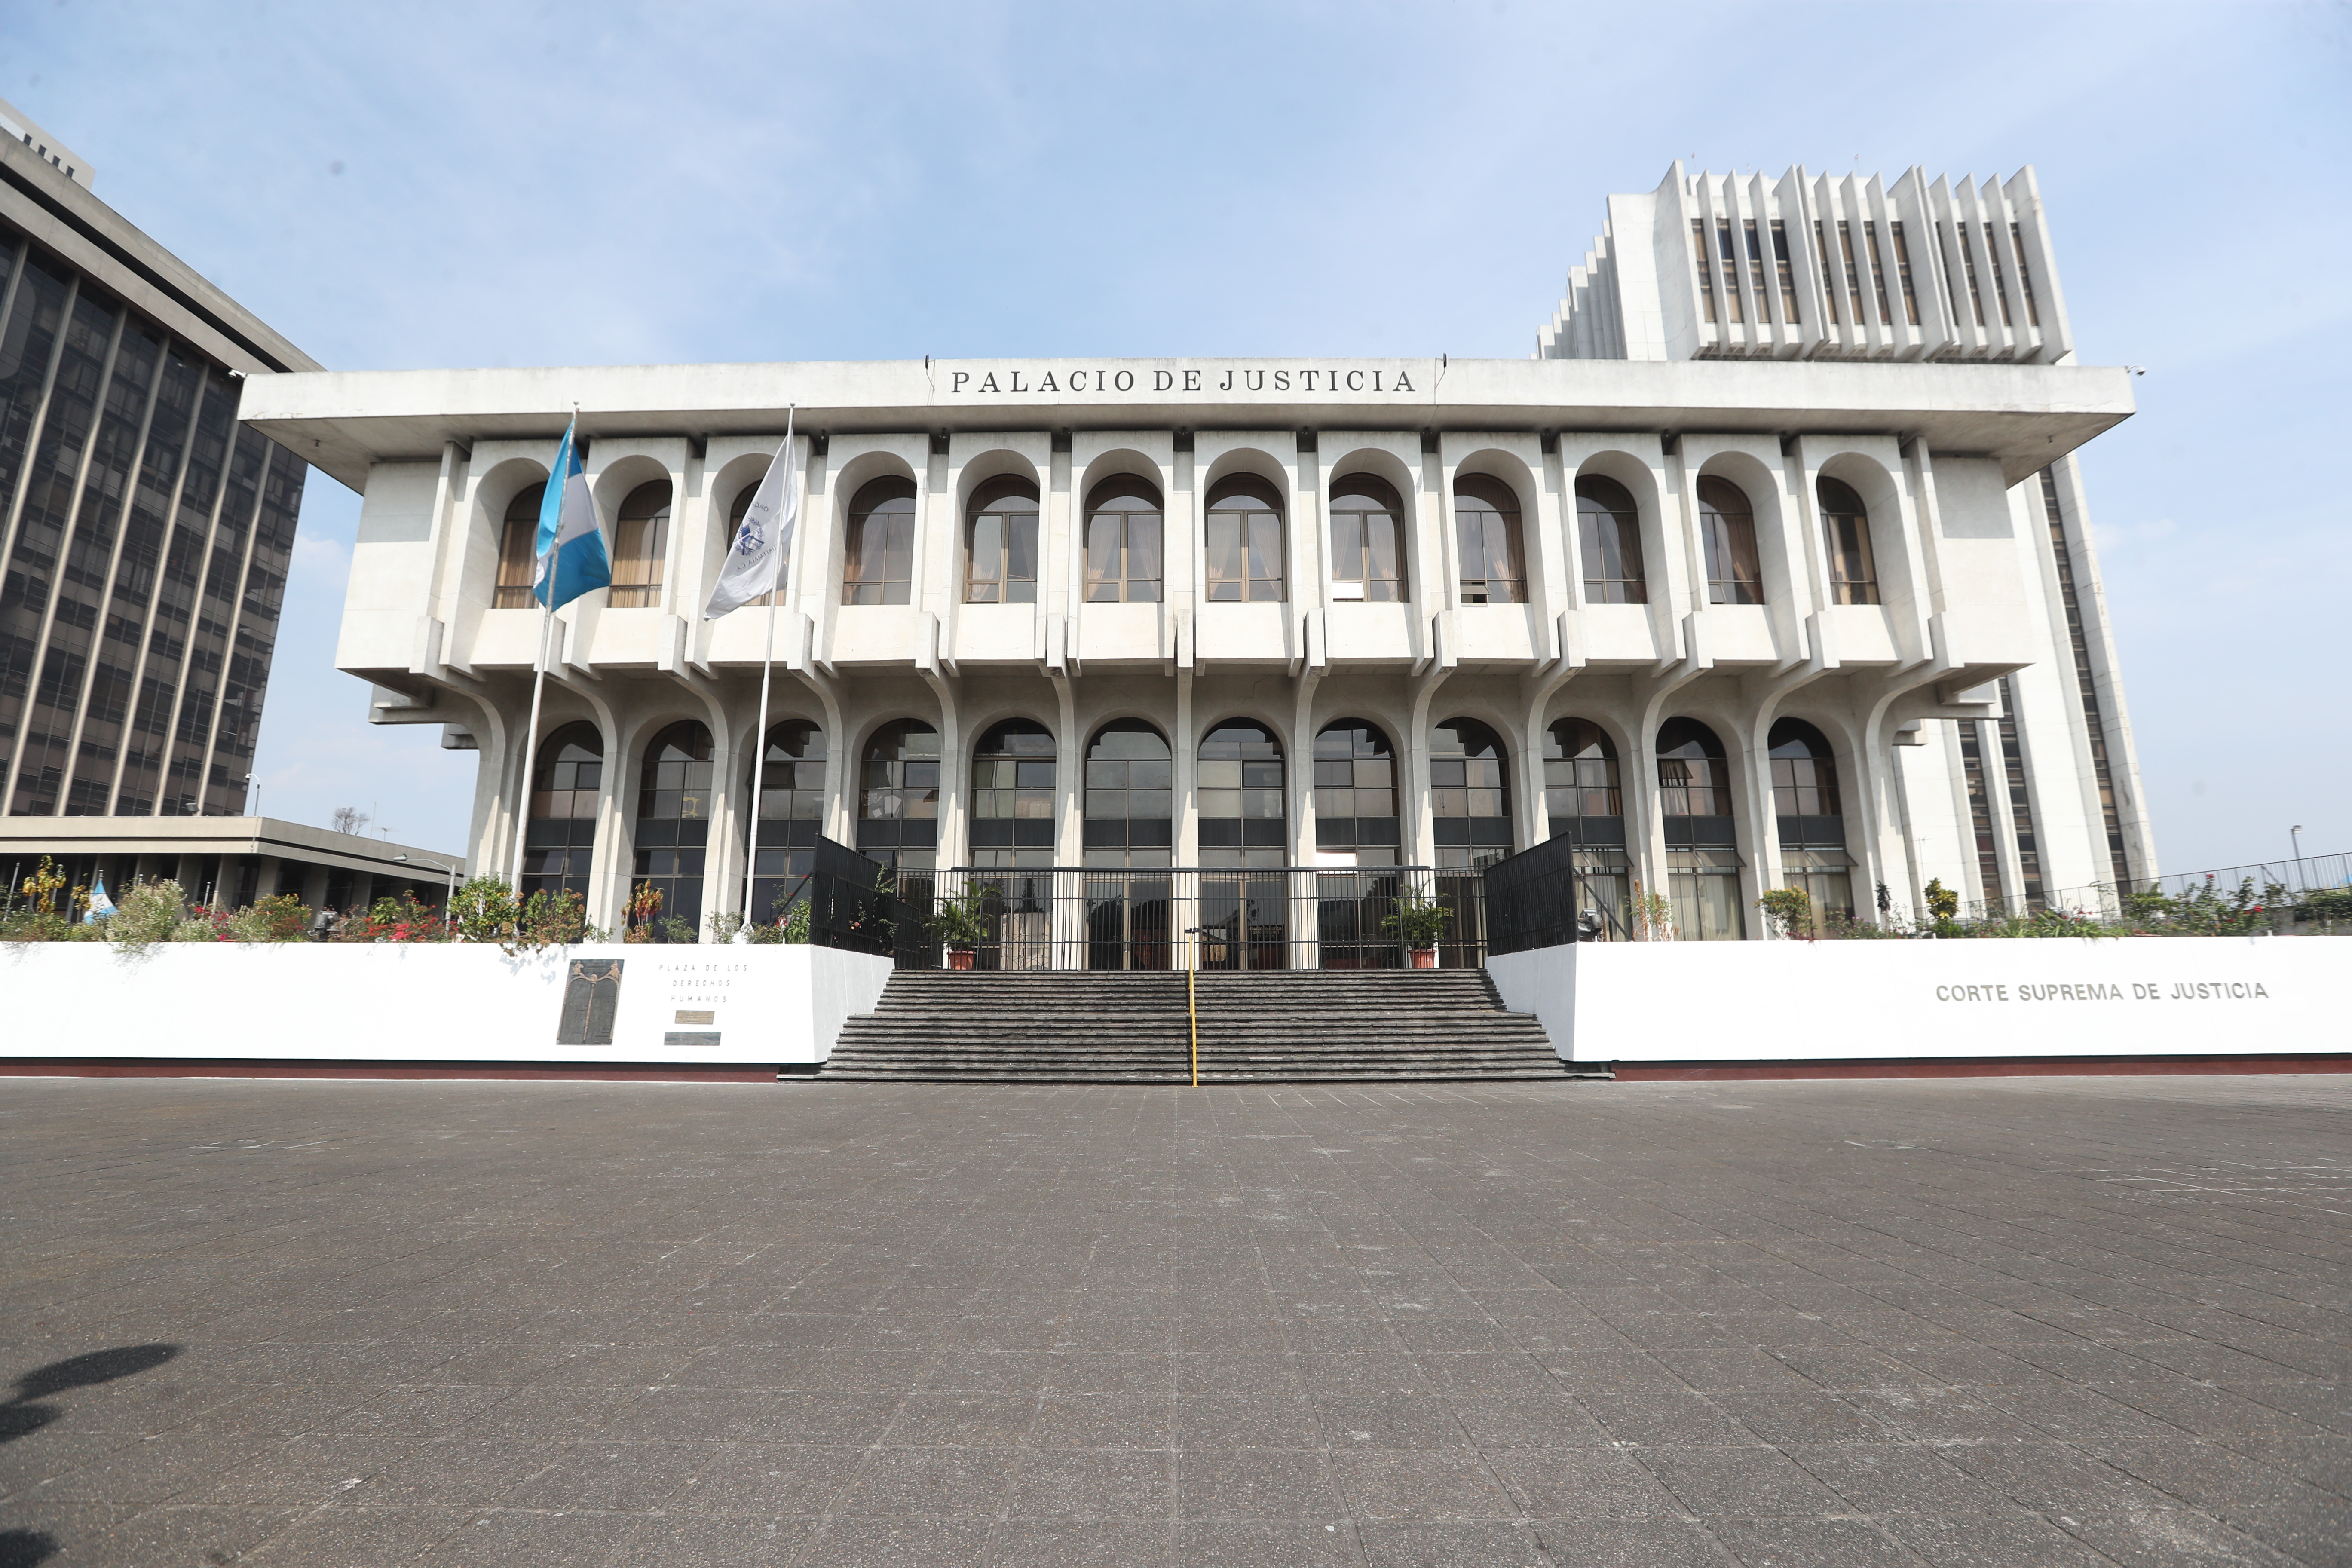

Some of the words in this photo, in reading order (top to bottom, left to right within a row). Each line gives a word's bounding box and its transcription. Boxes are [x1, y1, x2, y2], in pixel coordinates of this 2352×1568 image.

[951, 371, 1134, 392] PALACIO
[1153, 370, 1201, 391] DE
[1219, 370, 1416, 392] JUSTICIA
[1936, 985, 2009, 1001] CORTE
[2018, 984, 2124, 1001] SUPREMA
[2132, 983, 2161, 1000] DE
[2171, 983, 2269, 1000] JUSTICIA
